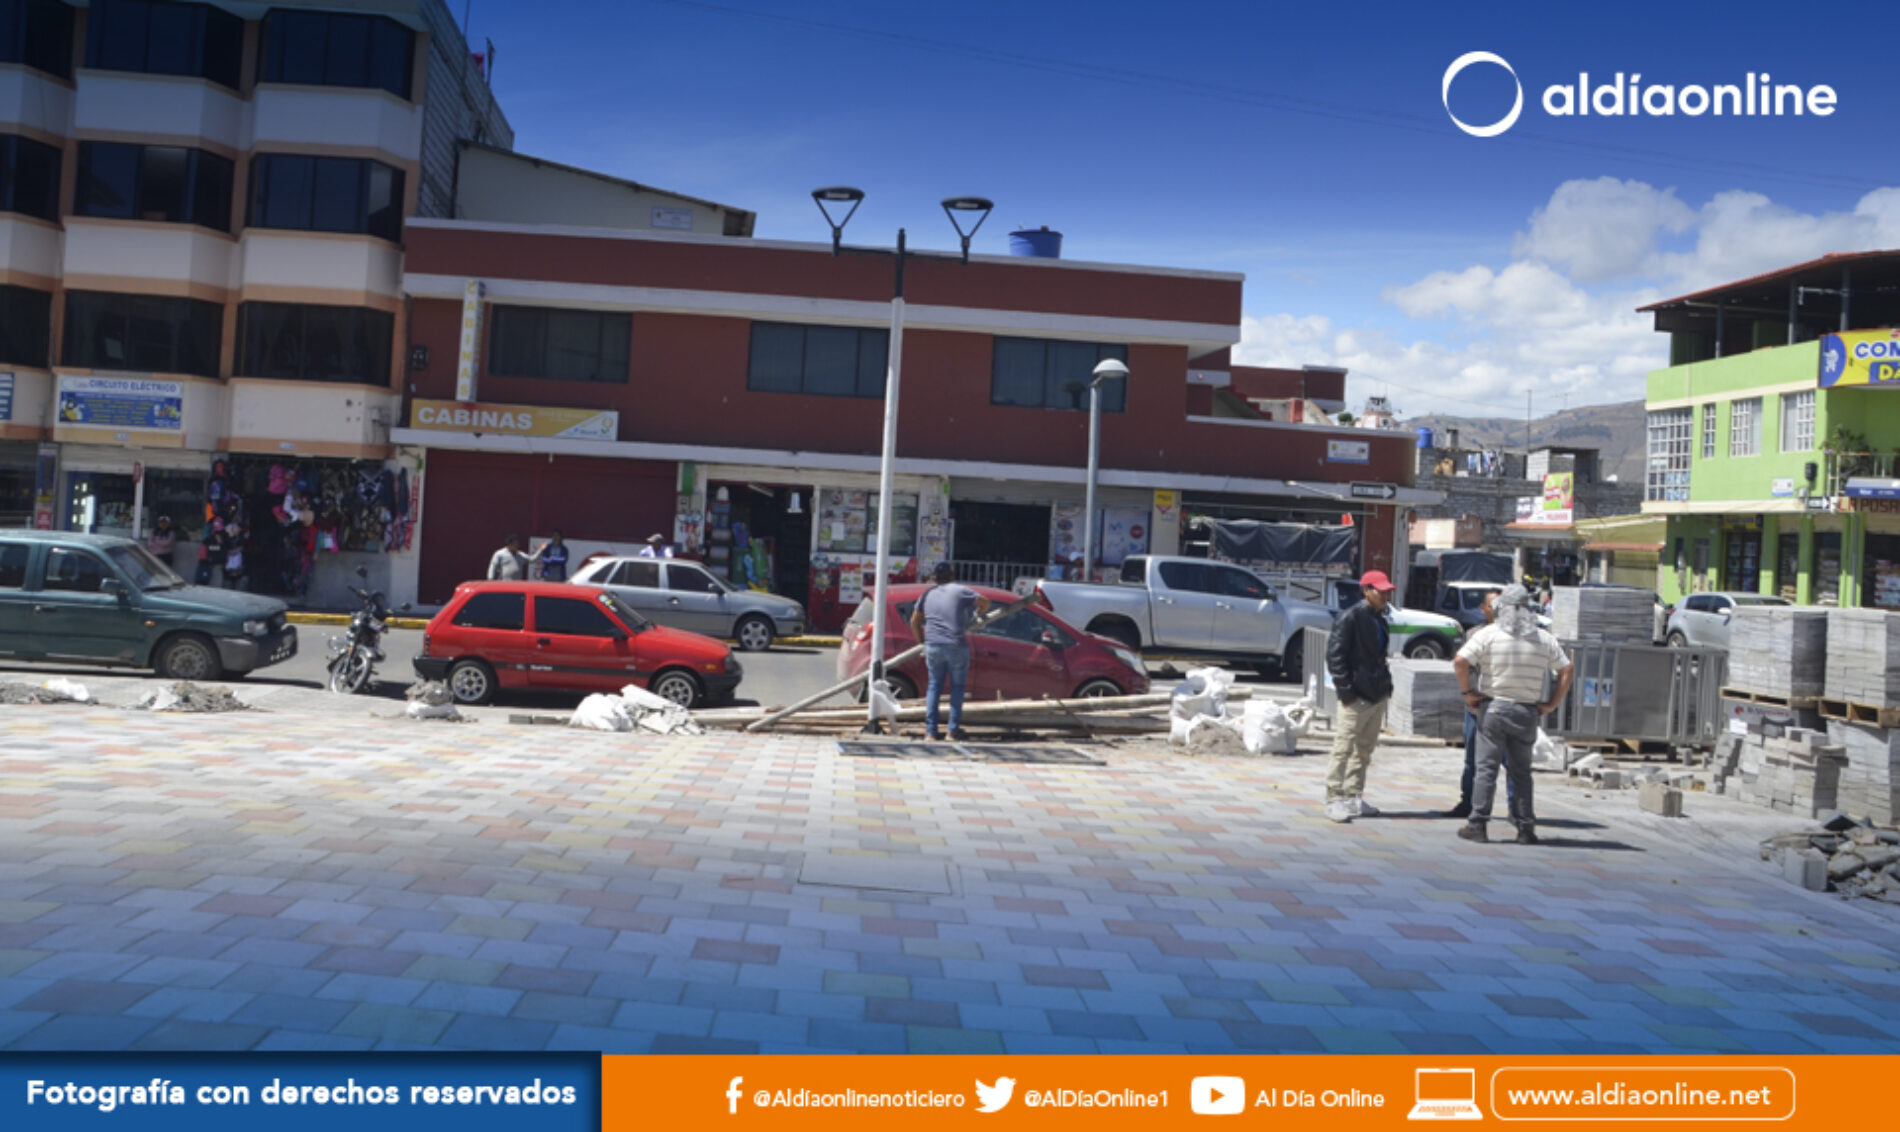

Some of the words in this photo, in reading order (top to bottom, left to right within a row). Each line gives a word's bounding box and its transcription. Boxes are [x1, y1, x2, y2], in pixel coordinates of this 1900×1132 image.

[460, 280, 478, 396] CABINAS
[89, 379, 129, 390] CIRCUITO
[130, 380, 177, 393] ELÉCTRICO
[417, 406, 534, 431] CABINAS
